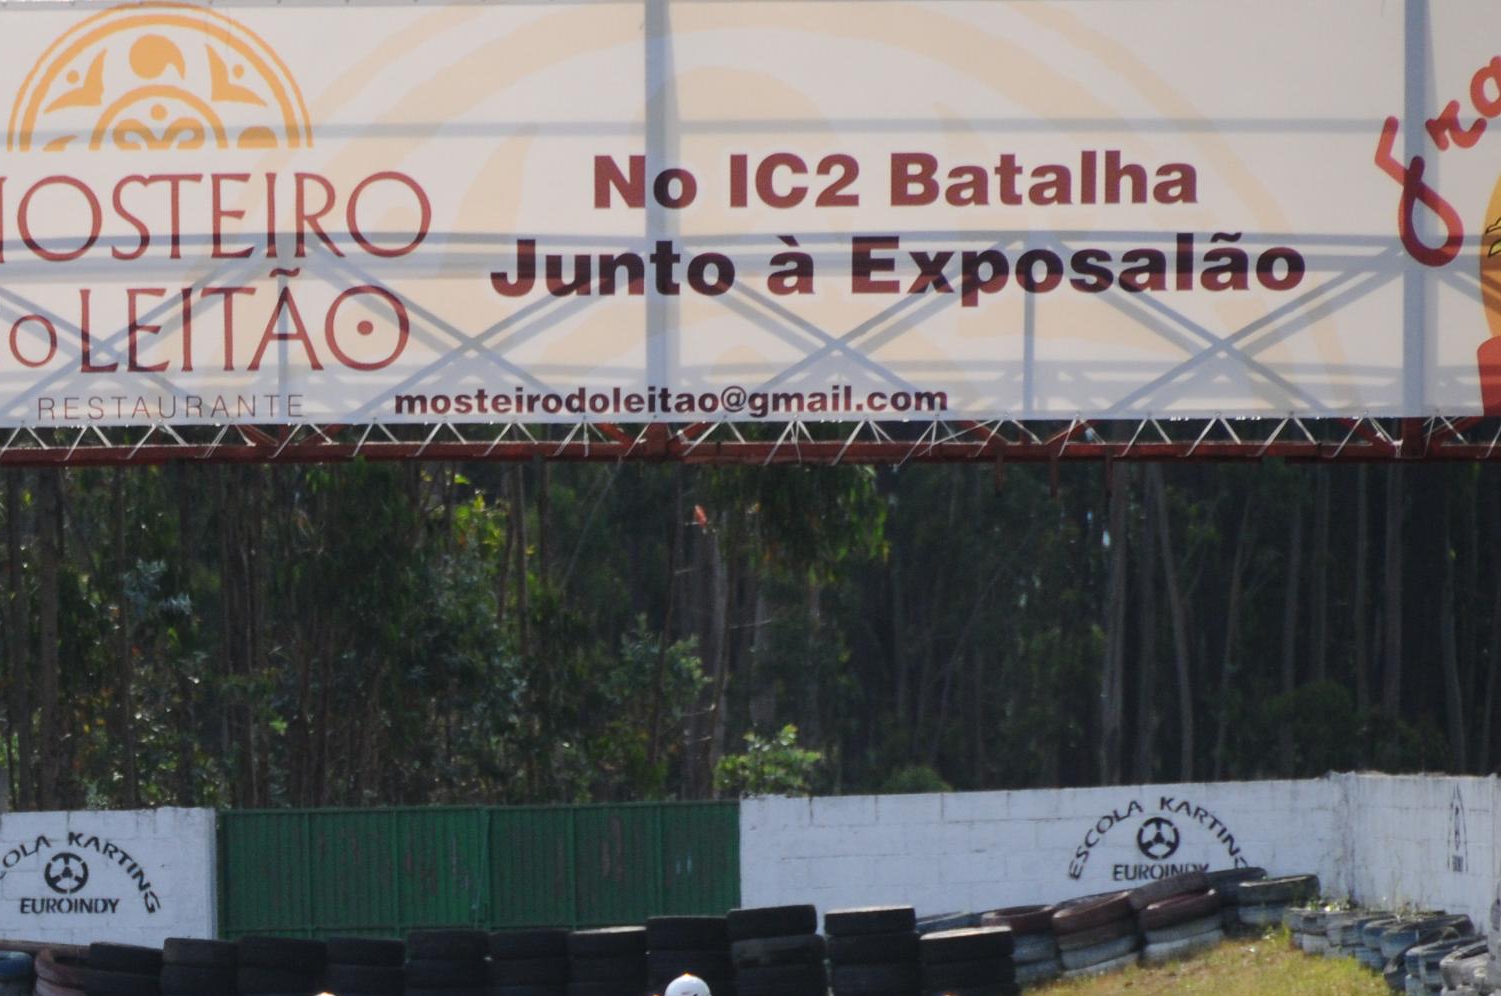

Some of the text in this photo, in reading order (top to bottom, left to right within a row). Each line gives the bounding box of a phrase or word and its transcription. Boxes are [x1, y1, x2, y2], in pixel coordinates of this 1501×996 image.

[593, 150, 1198, 209] No IC2 Batalha
[490, 231, 1306, 308] Junto à Exposalão
[79, 266, 411, 374] LEITÃO
[37, 393, 305, 421] RESTAURANTE
[394, 386, 949, 419] mosteirodoleitao@gmail.com
[67, 831, 161, 914] KARTING
[1068, 800, 1143, 880] ESCOLA
[19, 897, 120, 914] EUROINDY
